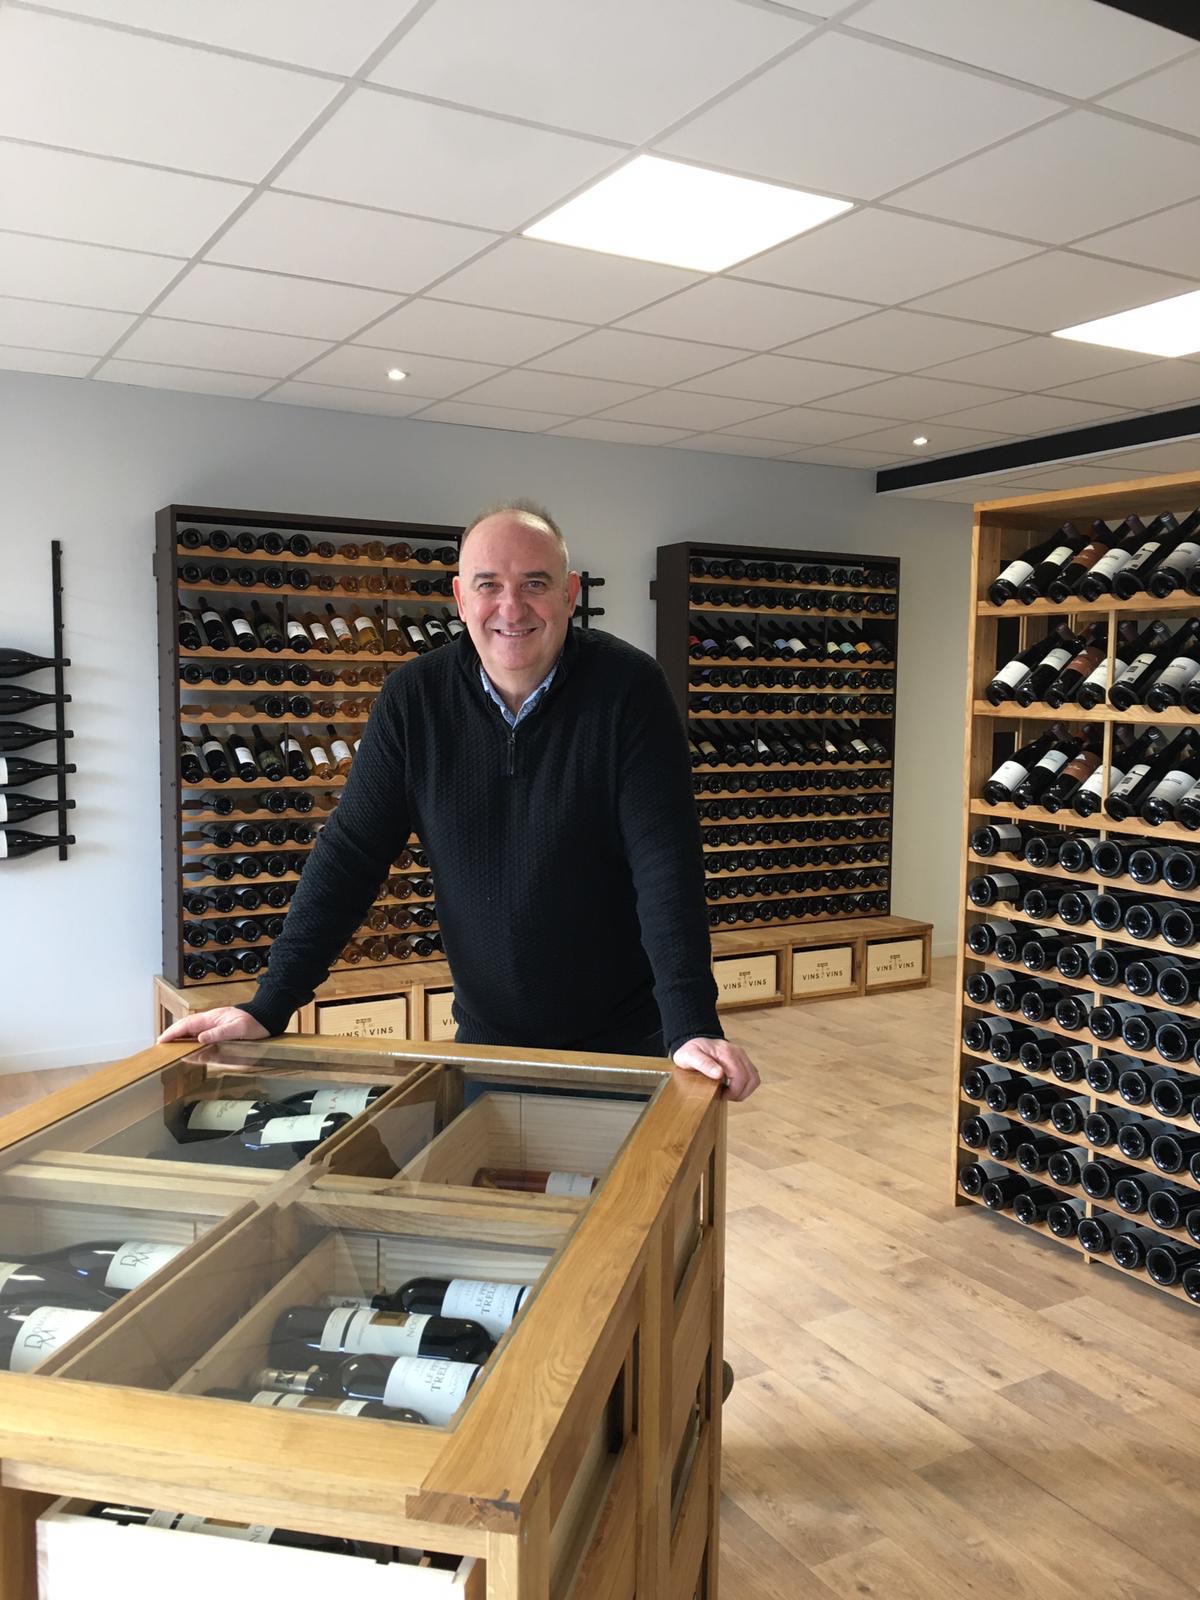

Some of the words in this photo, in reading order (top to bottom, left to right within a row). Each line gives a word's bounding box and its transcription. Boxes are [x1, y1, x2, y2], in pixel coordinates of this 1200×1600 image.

[802, 973, 820, 981] VINS
[826, 970, 843, 978] VINS
[723, 981, 742, 990] VINS
[748, 978, 767, 987] VINS
[442, 1018, 456, 1026] VI
[369, 1026, 394, 1036] VINS
